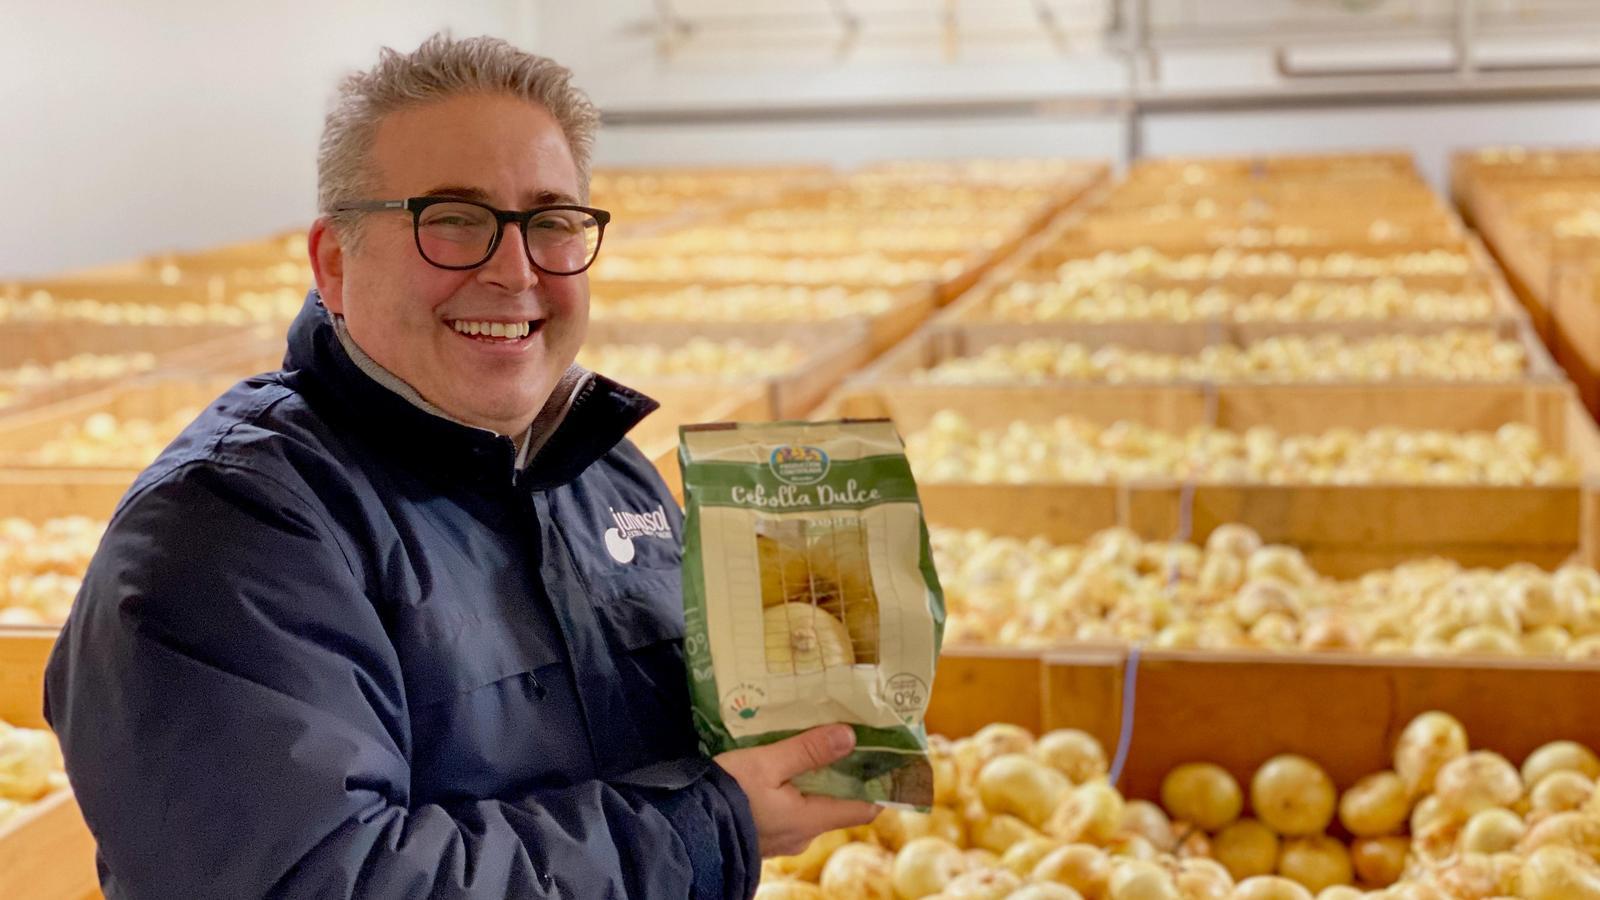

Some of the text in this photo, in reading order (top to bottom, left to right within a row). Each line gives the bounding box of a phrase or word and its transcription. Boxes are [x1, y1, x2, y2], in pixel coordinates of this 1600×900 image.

[731, 479, 881, 507] Cebolla Dulce
[894, 690, 921, 706] 0%
